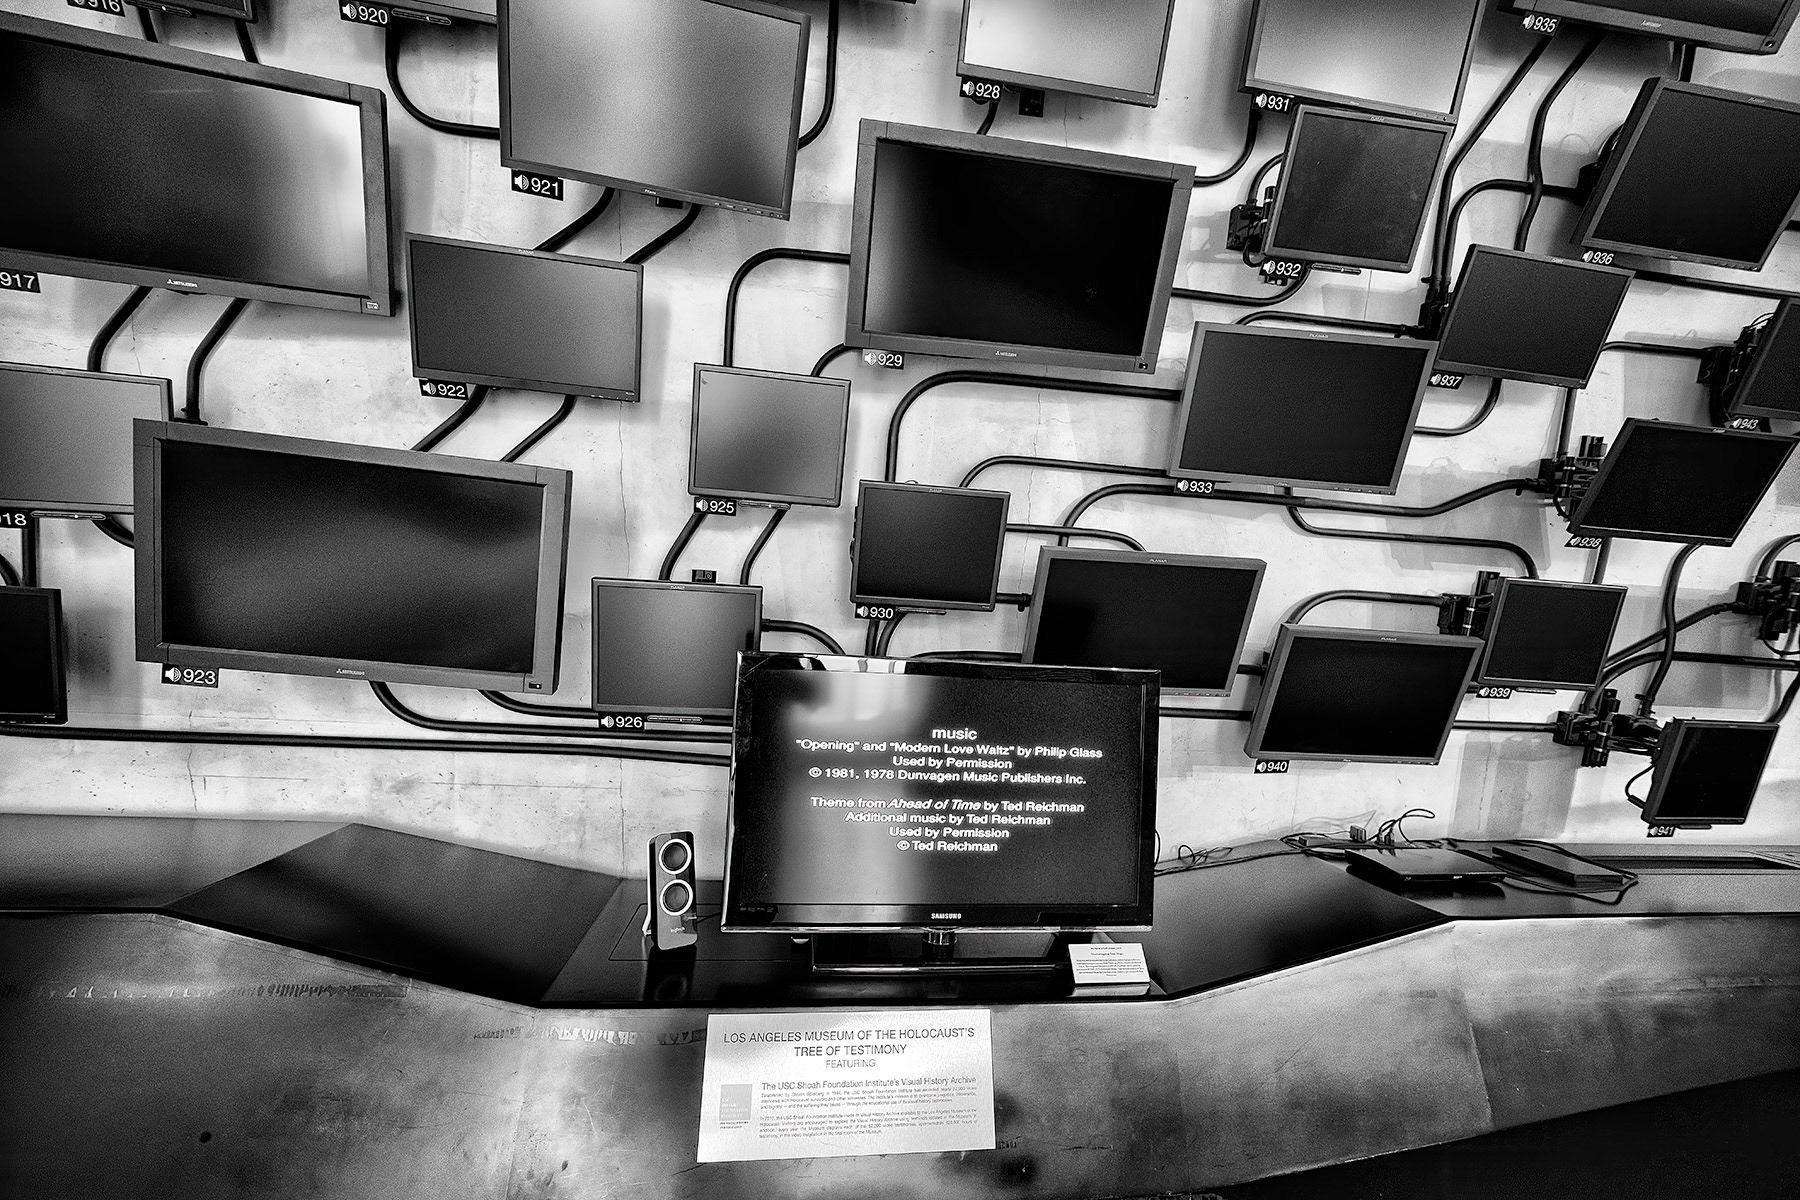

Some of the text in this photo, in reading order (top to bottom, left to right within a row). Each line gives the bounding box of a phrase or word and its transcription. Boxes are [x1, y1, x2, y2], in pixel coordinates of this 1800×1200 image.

[358, 5, 388, 25] 920
[1532, 15, 1557, 33] 935
[975, 82, 1000, 99] 928
[1267, 95, 1289, 112] 931
[533, 177, 557, 197] 921
[1592, 250, 1614, 265] 936
[1275, 261, 1299, 277] 932
[0, 271, 35, 289] 917
[877, 353, 901, 368] 929
[1440, 374, 1461, 387] 937
[437, 383, 464, 398] 922
[1188, 480, 1212, 494] 933
[709, 500, 733, 514] 925
[0, 512, 27, 526] 18
[1579, 536, 1600, 548] 938
[868, 607, 893, 619] 930
[183, 668, 216, 685] 923
[1490, 686, 1511, 698] 939
[615, 716, 642, 728] 926
[932, 728, 977, 740] music
[796, 739, 1103, 759] "Opening" and "Modern Love Waltz" by Philip Glass
[892, 755, 1013, 769] Used by Permission
[1267, 761, 1287, 772] 940
[825, 768, 860, 780] 1981,
[863, 768, 895, 780] 1978
[897, 769, 960, 783] Dunvagen
[963, 771, 999, 782] Music
[1001, 772, 1063, 783] Publishers
[1065, 774, 1087, 785] Inc.
[810, 796, 1085, 812] Theme from Ahead of Time by Ted Reichman
[845, 811, 1051, 825] Additional music by Ted Reichman
[889, 826, 1010, 839] Used by Permission
[1657, 826, 1673, 836] 941
[912, 840, 934, 851] Ted
[937, 841, 998, 852] Reichman
[723, 1027, 975, 1043] LOS ANGELES MUSEUM OF THE HOLOCAUST'S
[794, 1044, 907, 1057] TREE OF TESTIMONY
[825, 1058, 876, 1068] FEATURING
[761, 1075, 977, 1091] The USC Shoah Foundation Institute's Visual History Archive
